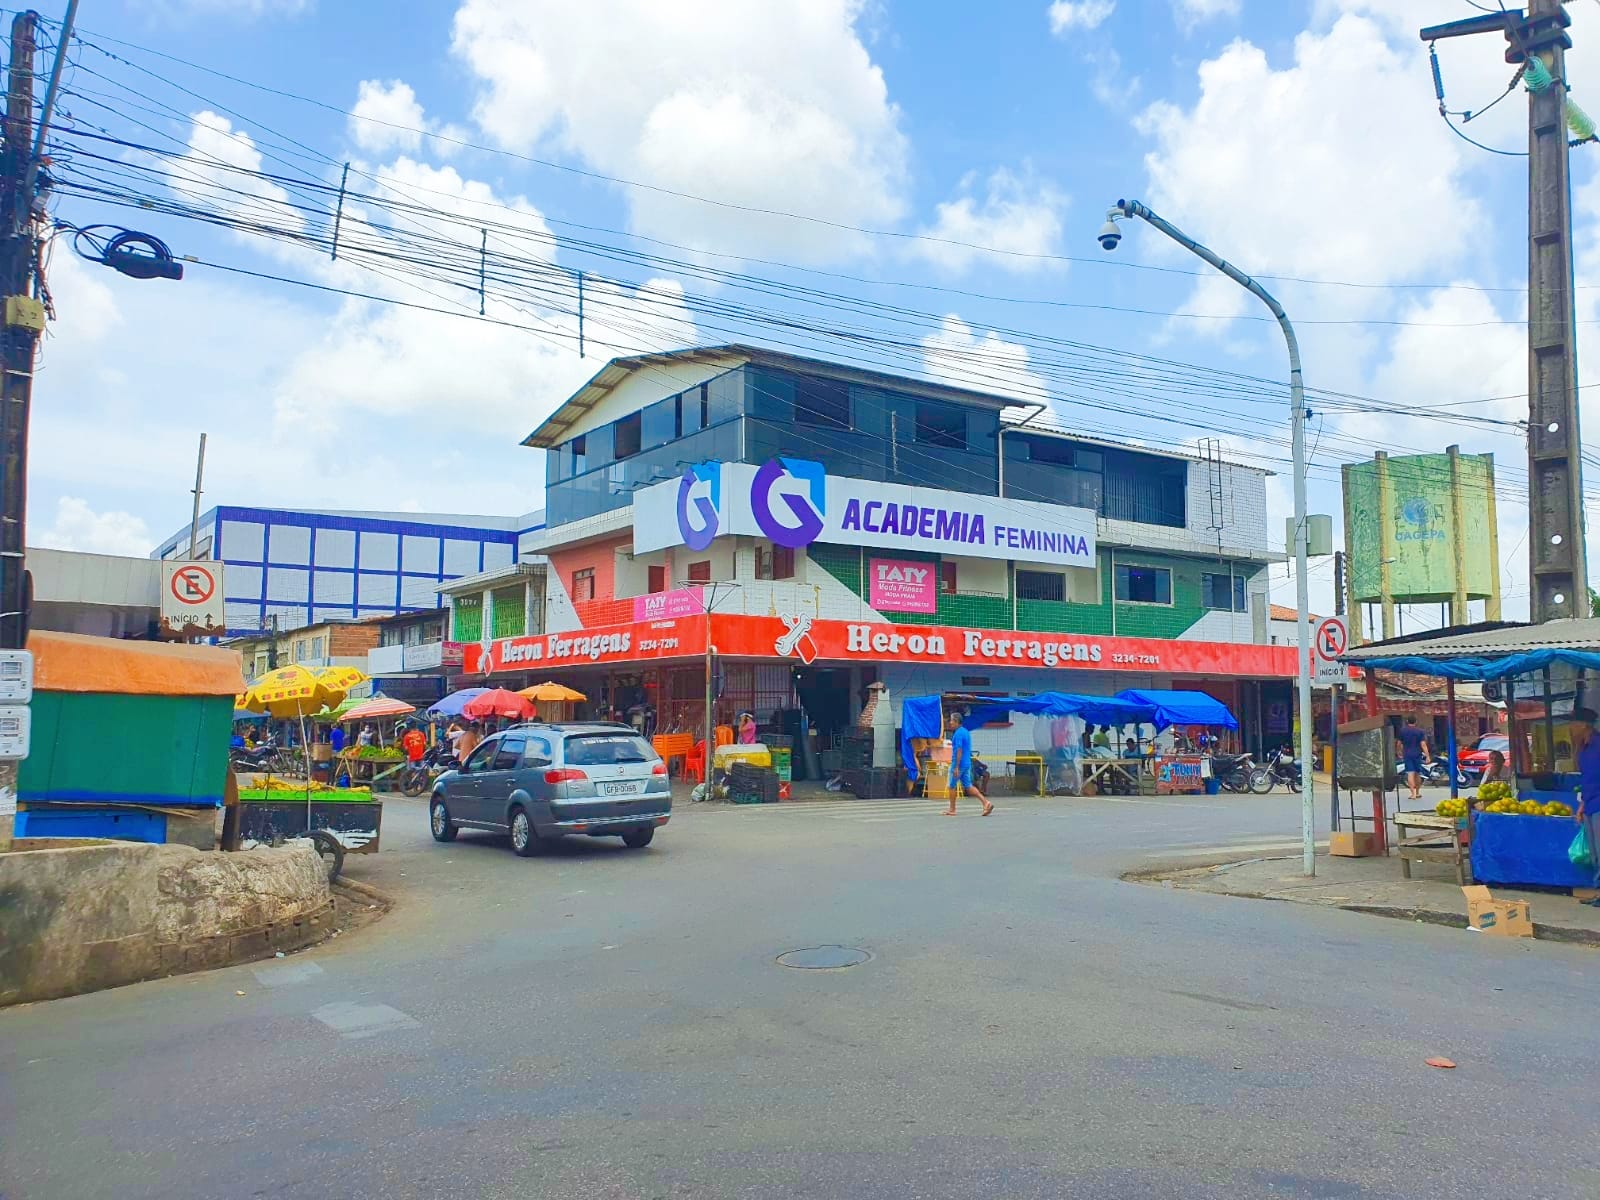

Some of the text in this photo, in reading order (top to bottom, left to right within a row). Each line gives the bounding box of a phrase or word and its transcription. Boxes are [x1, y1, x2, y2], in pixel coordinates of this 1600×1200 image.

[841, 498, 1089, 556] ACADEMIA FEMININA
[186, 575, 200, 594] E
[877, 565, 927, 583] TATY
[501, 631, 632, 664] Heron Ferragens
[846, 625, 1102, 667] Heron Ferragens
[1111, 653, 1160, 665] 3234-7201
